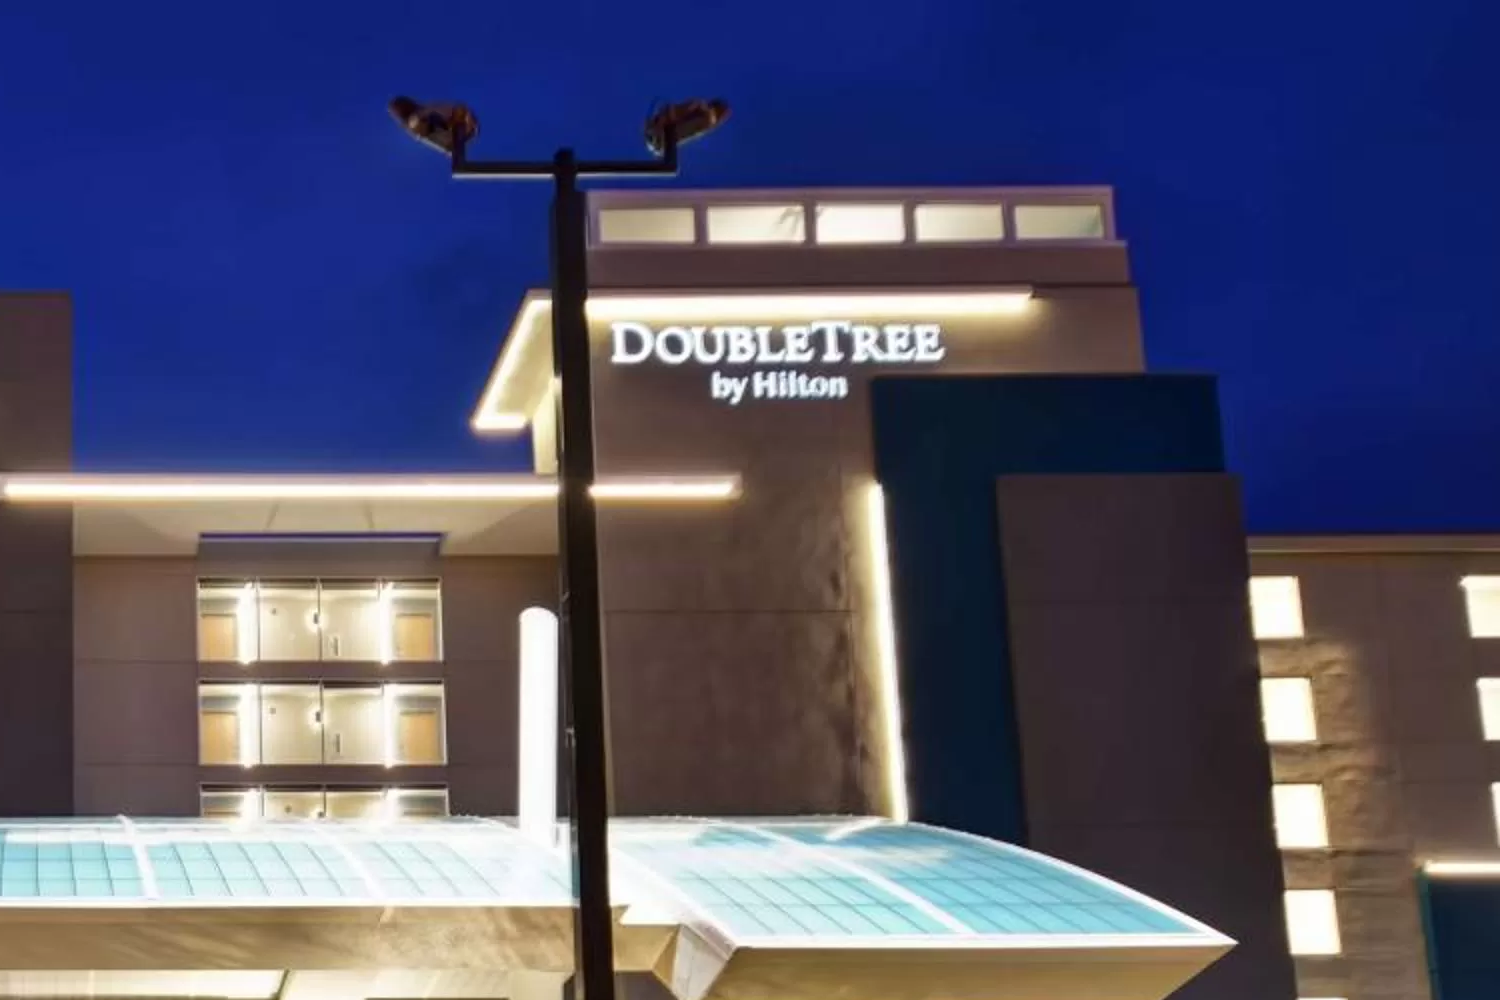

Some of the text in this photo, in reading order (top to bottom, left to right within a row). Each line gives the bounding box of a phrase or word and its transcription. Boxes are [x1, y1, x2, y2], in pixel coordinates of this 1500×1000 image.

[611, 320, 946, 365] DOUBLETREE
[711, 370, 848, 405] by Hilton
